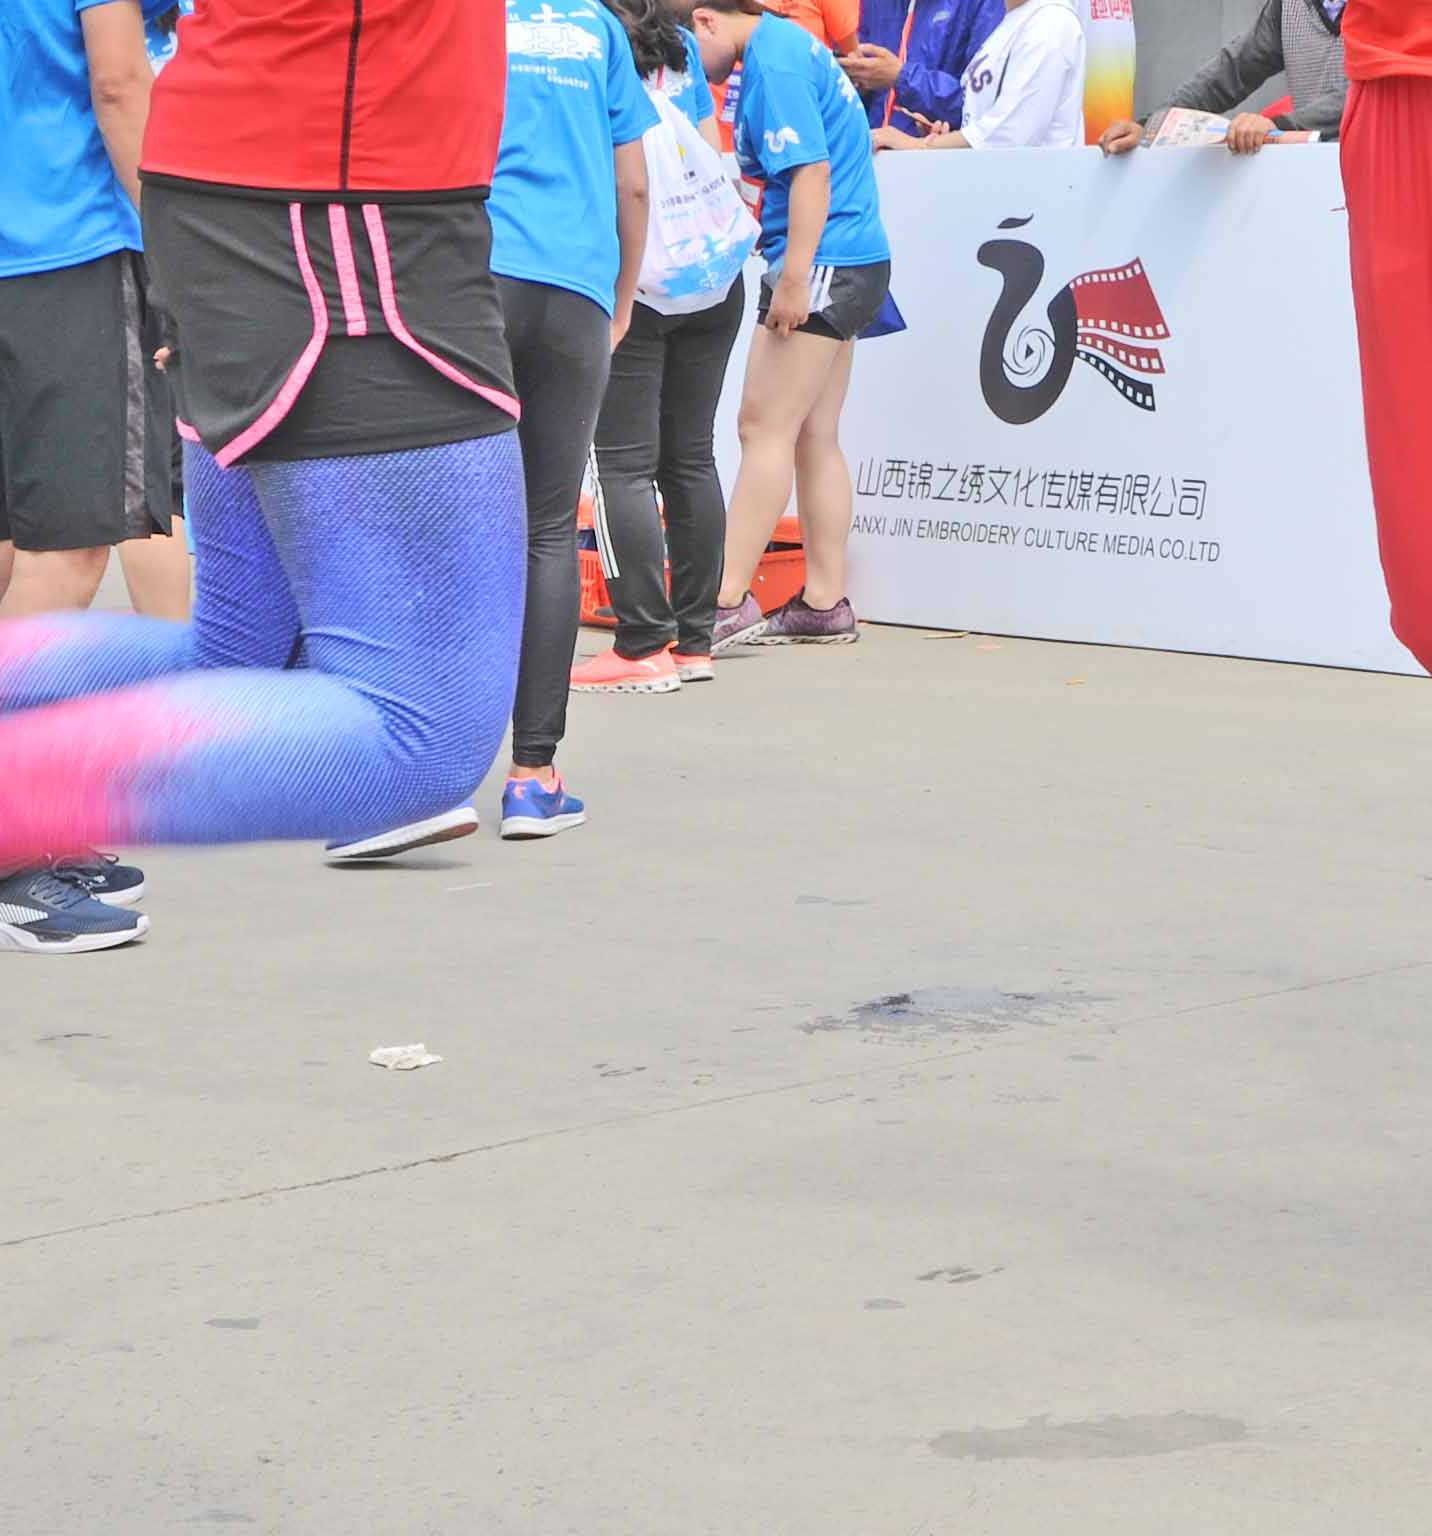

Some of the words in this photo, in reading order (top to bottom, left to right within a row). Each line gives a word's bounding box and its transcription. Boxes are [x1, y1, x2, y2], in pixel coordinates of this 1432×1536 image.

[856, 457, 1208, 521] 山西锦之绣文化传媒有限公司
[890, 517, 914, 538] JIN
[916, 519, 1020, 546] EMBROIDERY
[1024, 527, 1099, 553] CULTURE
[1103, 533, 1155, 558] MEDIA
[1159, 538, 1221, 562] CO.LTD
